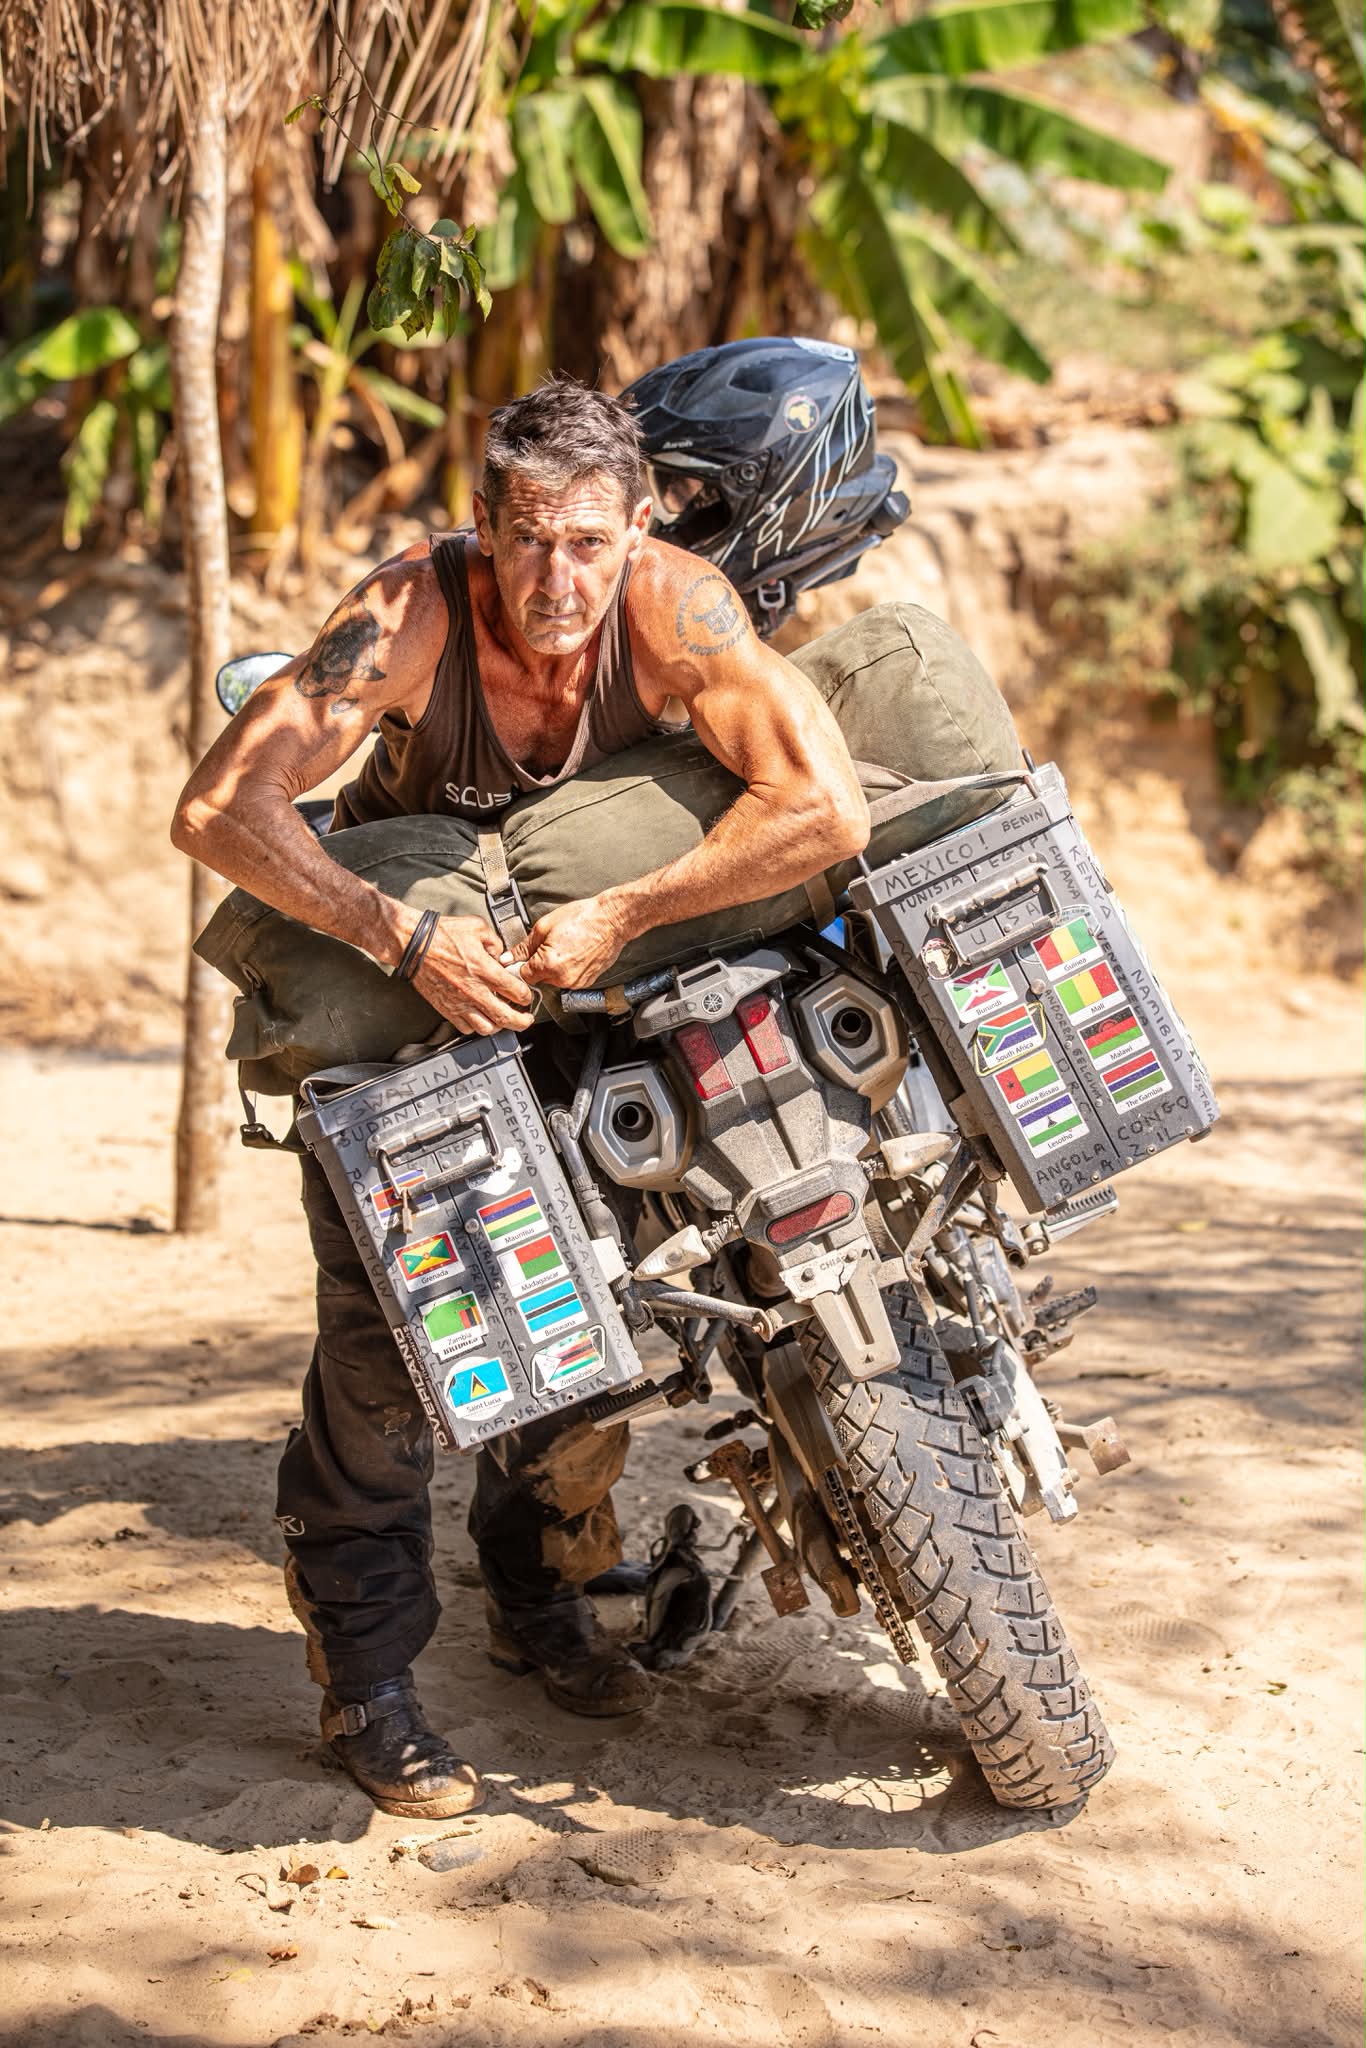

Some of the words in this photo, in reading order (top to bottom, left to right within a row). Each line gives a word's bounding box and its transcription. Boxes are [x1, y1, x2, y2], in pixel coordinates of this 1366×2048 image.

[445, 782, 513, 808] SCUB
[1002, 808, 1045, 833] BENIN
[1069, 845, 1113, 919] KENYA
[1063, 957, 1087, 972] Guinea
[975, 999, 1002, 1016] Burundi
[1091, 1002, 1105, 1014] Mali
[1130, 968, 1183, 1062] NAMIBIA
[995, 1048, 1017, 1063] South
[1016, 1041, 1034, 1055] Africa
[1110, 1045, 1133, 1061] Malawi
[436, 1071, 493, 1105] MALI
[1015, 1084, 1060, 1111] Guinea-Bissau
[1125, 1096, 1139, 1109] The
[1138, 1086, 1164, 1104] Gambia
[505, 1073, 547, 1156] UGANDA
[1117, 1095, 1190, 1141] CONGO
[339, 1107, 409, 1149] SUDAN
[496, 1095, 538, 1178] IRELAND
[1047, 1132, 1073, 1149] Lesotho
[1036, 1141, 1106, 1186] ANGOLA
[504, 1228, 535, 1244] Mauritius
[553, 1183, 609, 1305] TANZANIA
[542, 1201, 593, 1301] SCOTLAND
[420, 1269, 449, 1285] Grenada
[521, 1271, 560, 1292] Madagascar
[447, 1332, 473, 1346] Zambia
[544, 1319, 576, 1337] Botswana
[496, 1338, 526, 1394] SPAIN
[393, 1326, 449, 1447] OVERLAND
[466, 1402, 483, 1412] Saint
